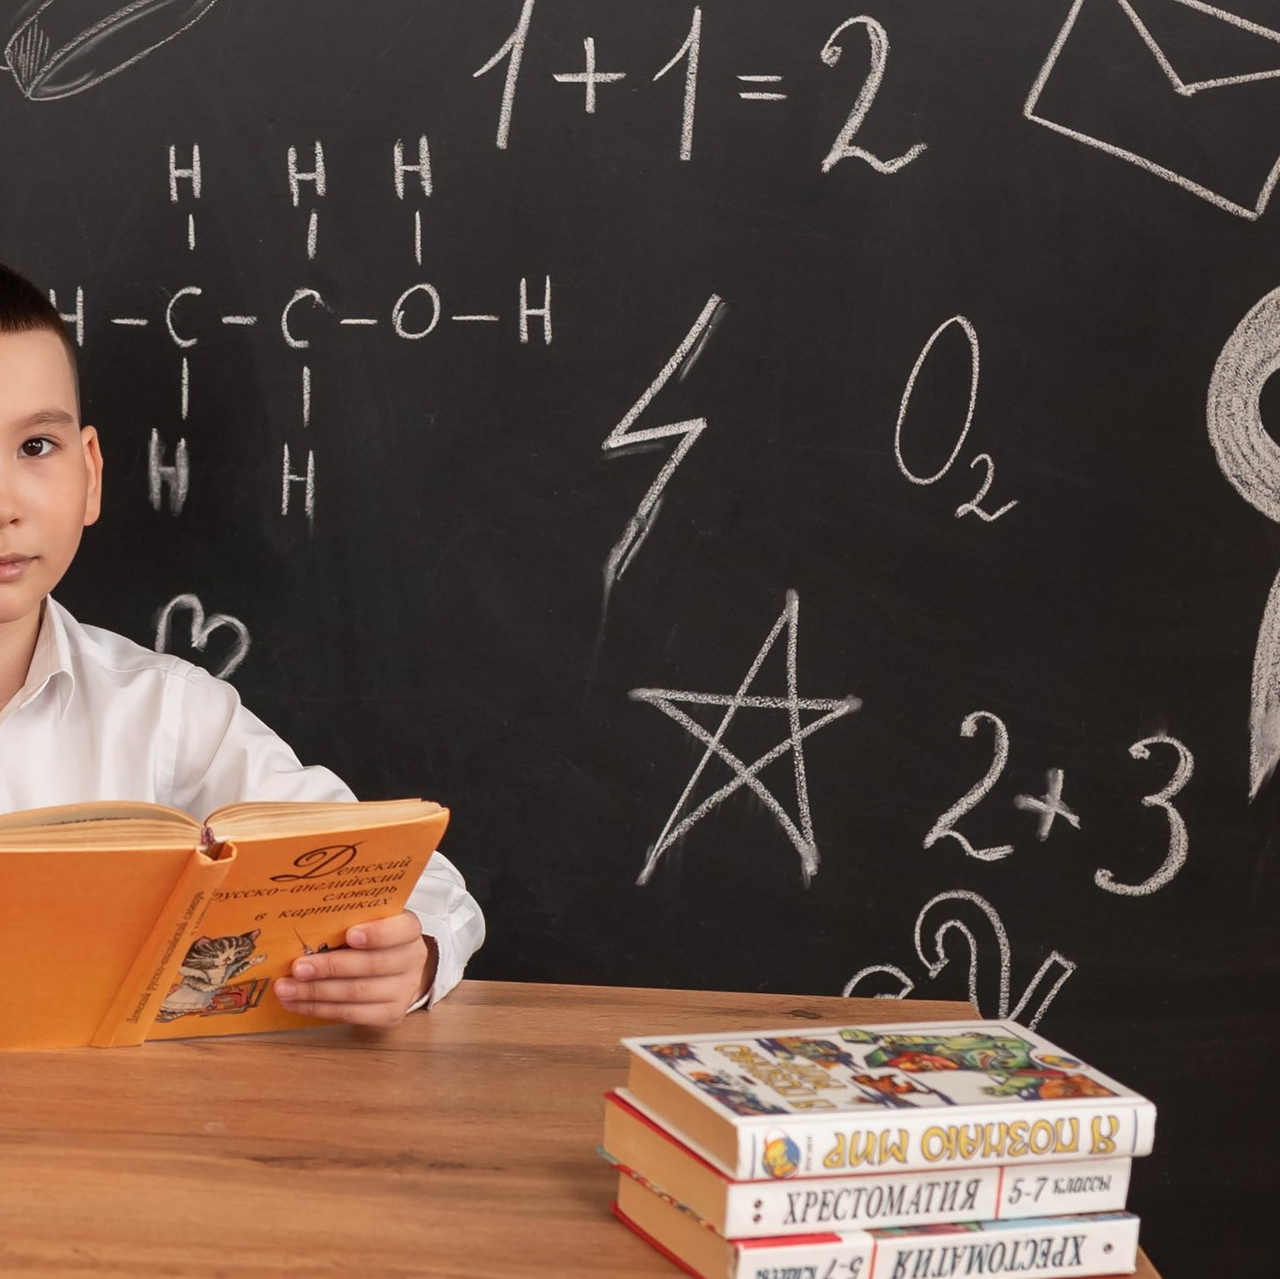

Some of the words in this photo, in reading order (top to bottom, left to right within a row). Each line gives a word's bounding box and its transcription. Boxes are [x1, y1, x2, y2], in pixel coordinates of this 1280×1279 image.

[269, 839, 414, 883] Детский
[212, 870, 407, 904] русско-английский
[322, 884, 399, 903] словарь
[253, 911, 268, 922] в
[277, 896, 396, 920] картинках
[822, 1127, 911, 1170] МИР
[920, 1117, 1081, 1163] ПОЗНАЮ
[1089, 1114, 1120, 1156] Я
[783, 1178, 983, 1224] ХРЕСТОМАТИЯ
[1007, 1175, 1048, 1205] 5-7
[1052, 1174, 1113, 1195] классы
